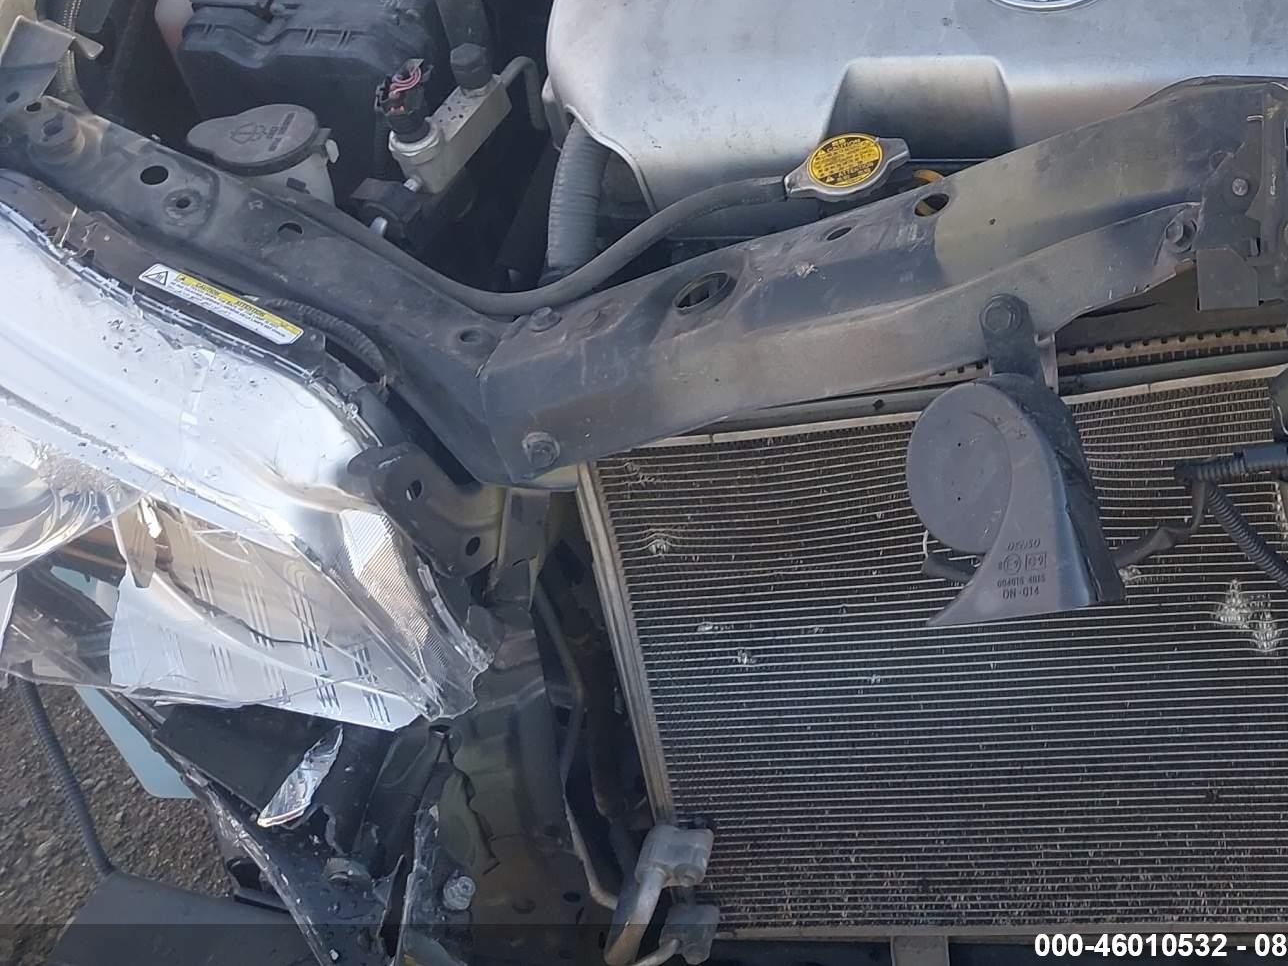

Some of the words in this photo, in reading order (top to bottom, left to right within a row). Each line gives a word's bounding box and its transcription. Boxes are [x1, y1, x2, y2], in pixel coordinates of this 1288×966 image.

[826, 138, 861, 153] CAUTION
[839, 163, 873, 177] ATTENTION
[195, 281, 220, 296] CAUTION
[235, 300, 266, 317] ATTENTION
